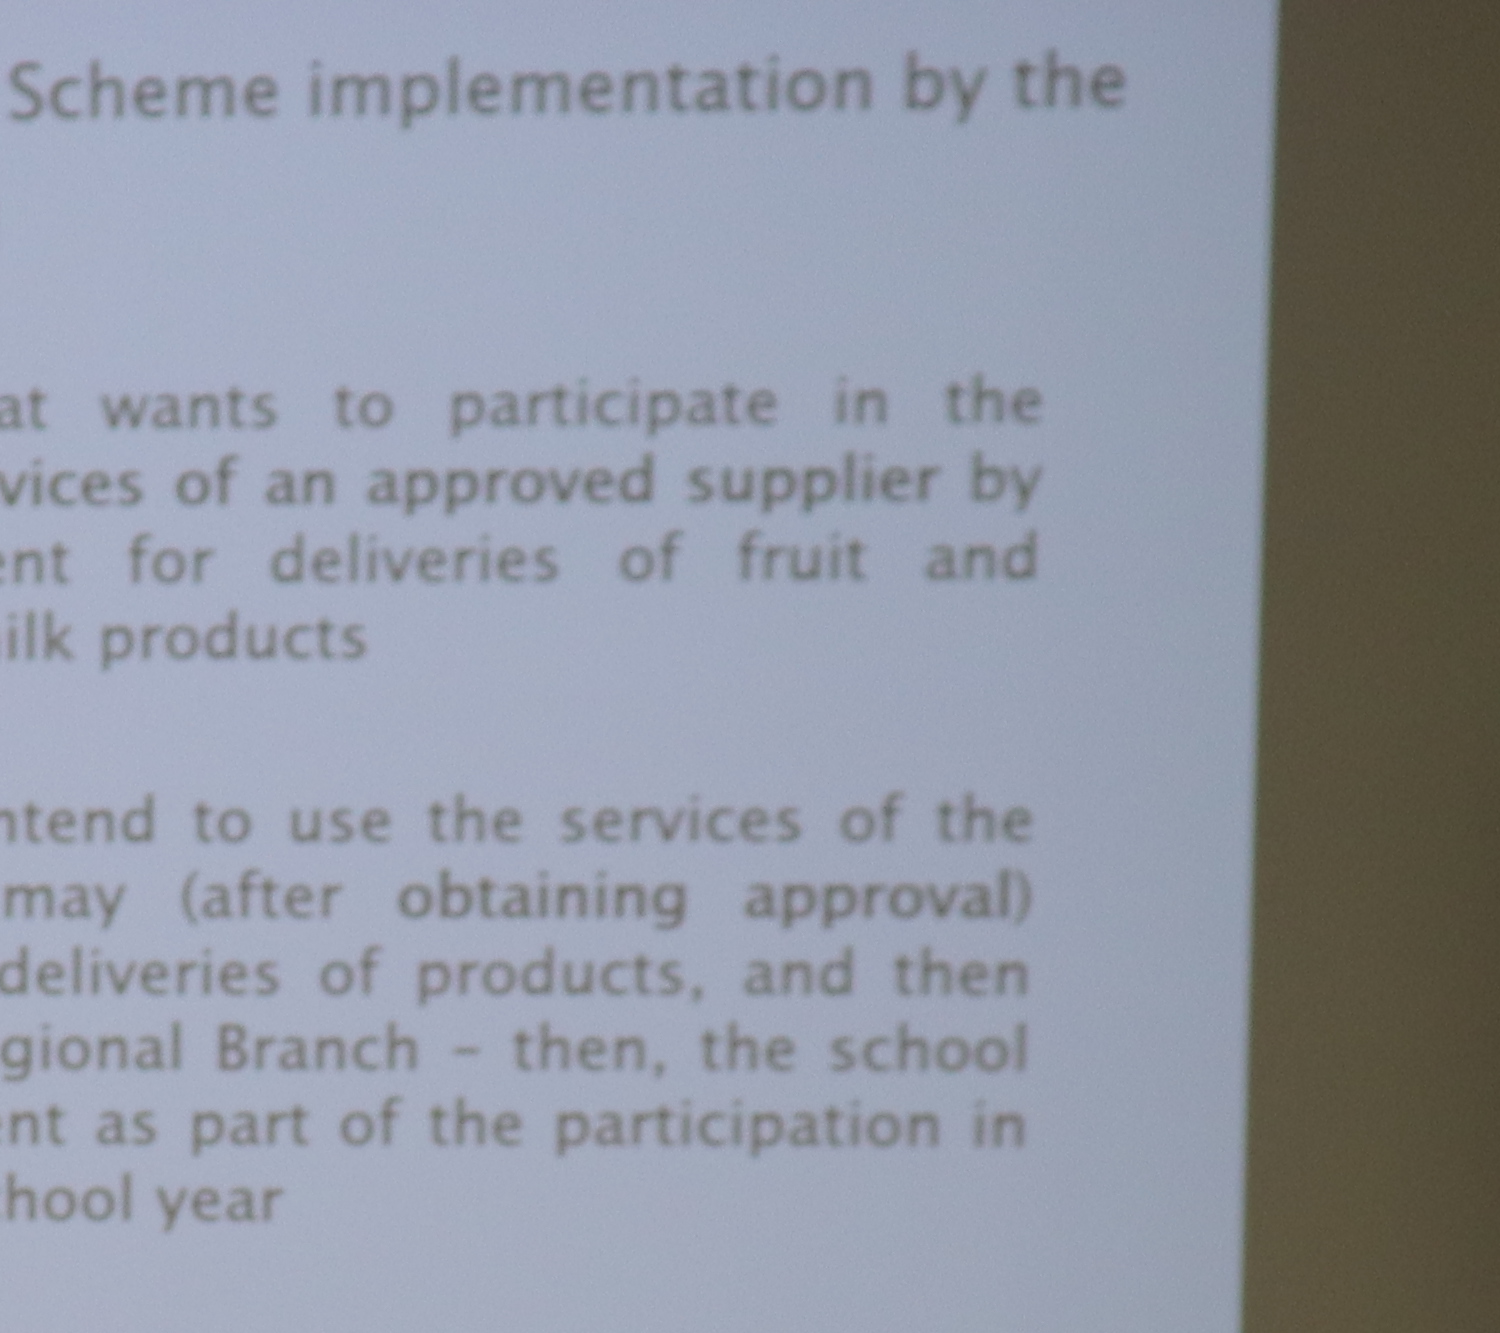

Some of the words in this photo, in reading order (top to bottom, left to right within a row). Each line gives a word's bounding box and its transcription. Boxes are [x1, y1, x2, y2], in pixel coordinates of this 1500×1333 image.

[7, 59, 279, 124] Scheme
[309, 55, 873, 131] implementation
[903, 50, 988, 125] by
[1012, 48, 1127, 111] the
[99, 386, 279, 431] wants
[333, 386, 395, 430] to
[449, 378, 778, 439] participate
[834, 377, 889, 425] in
[944, 373, 1043, 426] the
[173, 453, 239, 508] of
[264, 469, 336, 507] an
[365, 452, 656, 517] approved
[686, 451, 942, 515] supplier
[969, 450, 1043, 513] by
[128, 532, 215, 586] for
[269, 532, 560, 586] deliveries
[618, 529, 684, 584] of
[737, 529, 866, 583] fruit
[923, 529, 1038, 583] and
[100, 609, 368, 672] products
[192, 801, 253, 845] to
[289, 807, 392, 845] use
[427, 793, 523, 845] the
[560, 795, 803, 845] services
[839, 791, 904, 845] of
[936, 792, 1033, 845] the
[3, 883, 127, 930] may
[180, 868, 343, 925] (after
[396, 868, 688, 932] obtaining
[743, 868, 1033, 931] approval)
[318, 944, 382, 998] of
[416, 946, 704, 1007] products,
[742, 946, 855, 998] and
[893, 946, 1029, 998] then
[216, 1021, 419, 1073] Branch
[512, 1021, 666, 1078] then,
[700, 1021, 796, 1073] the
[830, 1022, 1028, 1074] school
[95, 1110, 158, 1147] as
[190, 1104, 309, 1157] part
[339, 1095, 402, 1148] of
[428, 1096, 523, 1148] the
[555, 1100, 940, 1158] participation
[973, 1102, 1026, 1148] in
[155, 1186, 284, 1233] year
